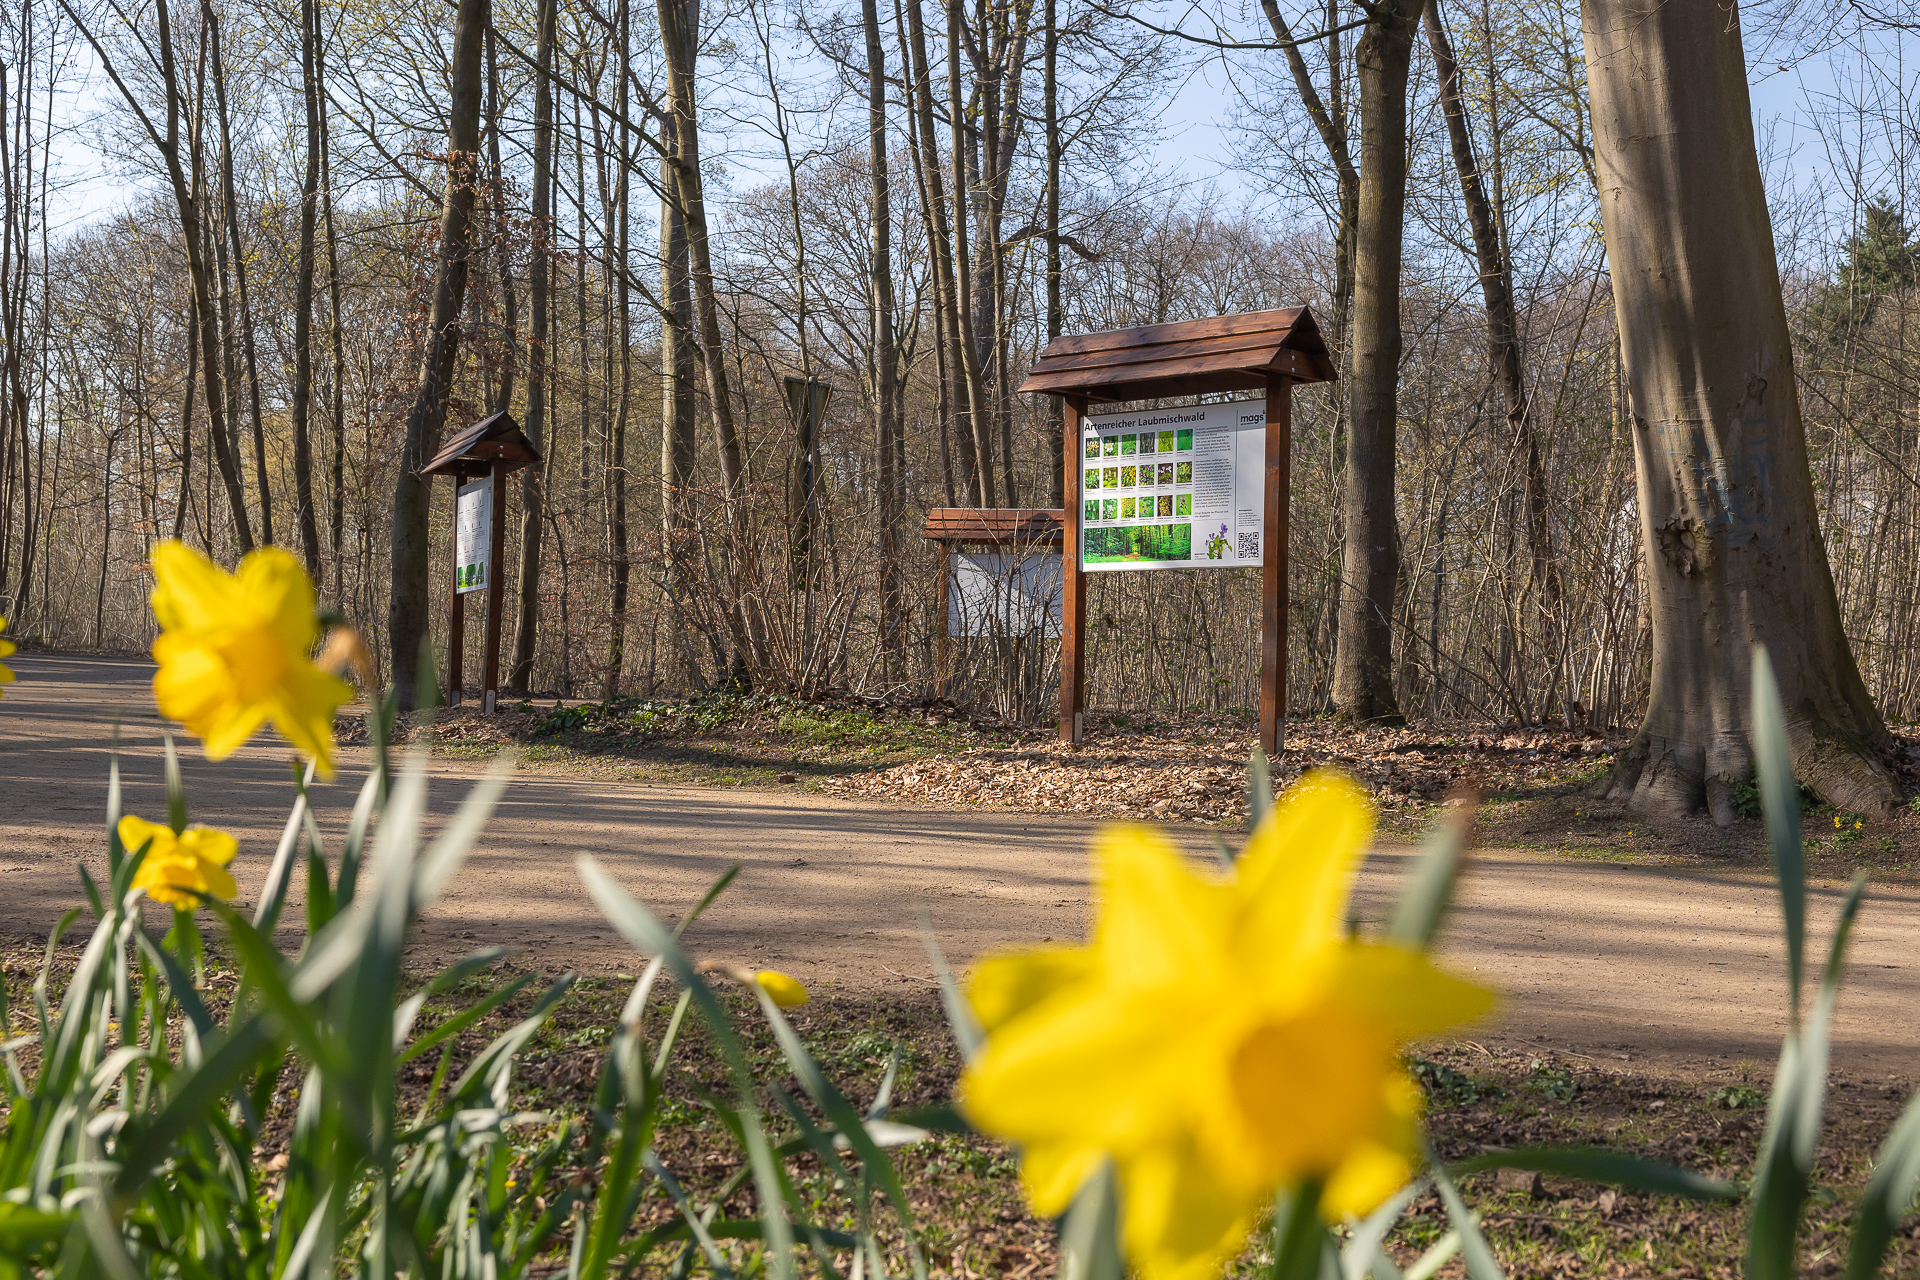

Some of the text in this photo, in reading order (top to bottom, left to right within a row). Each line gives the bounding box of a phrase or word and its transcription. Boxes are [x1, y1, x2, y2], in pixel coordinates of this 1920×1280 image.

[1084, 412, 1205, 431] Artenreicher Laubmischwald
[1240, 414, 1264, 424] mags
